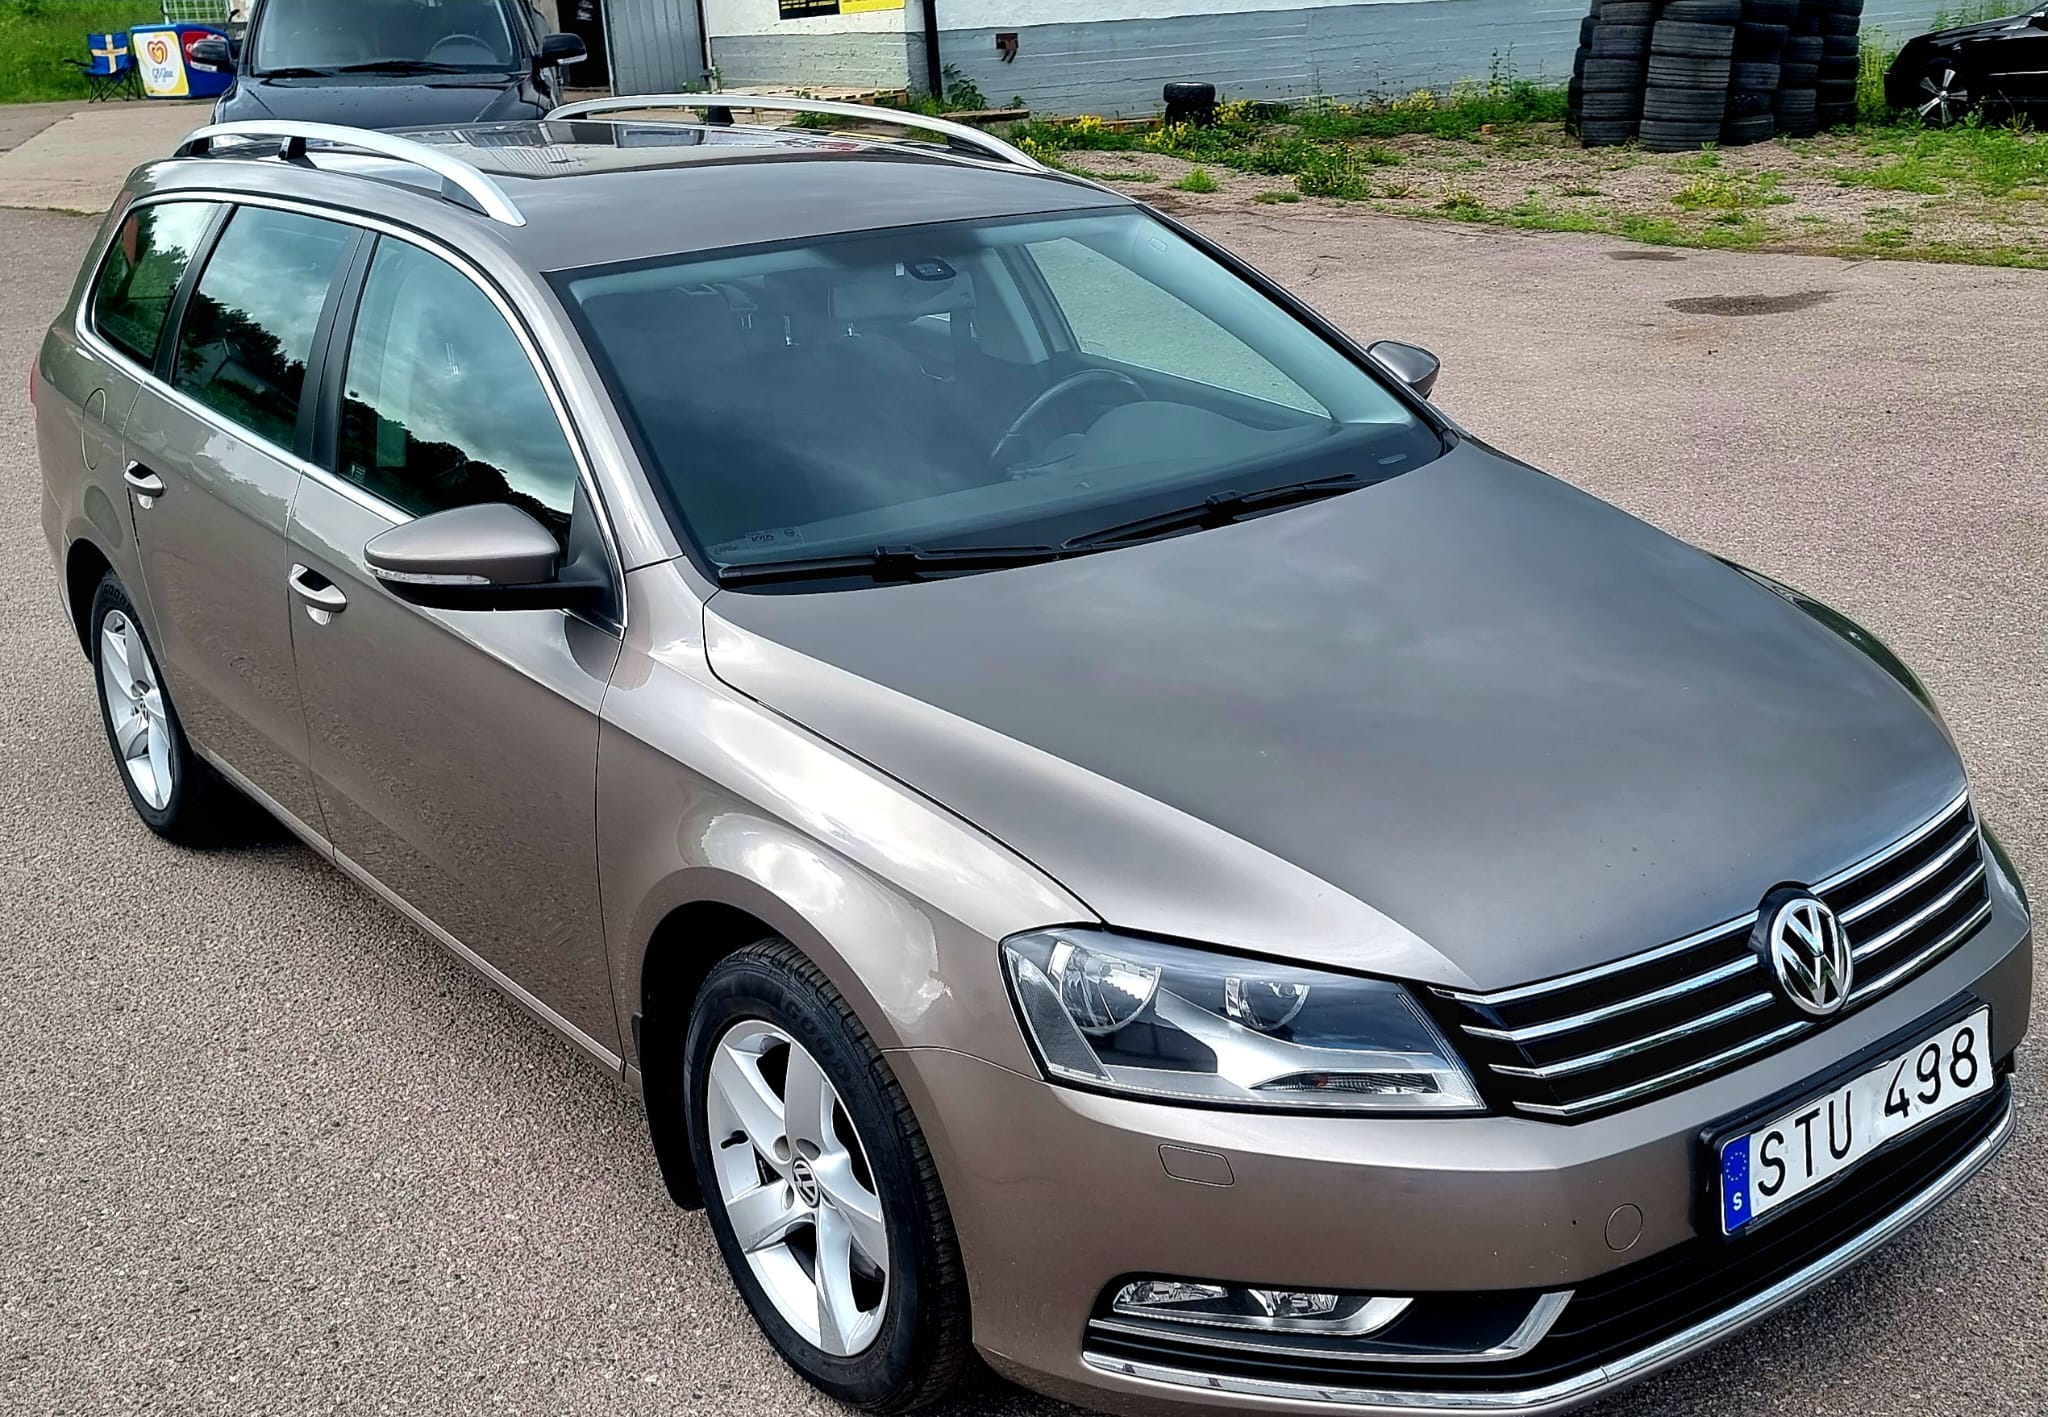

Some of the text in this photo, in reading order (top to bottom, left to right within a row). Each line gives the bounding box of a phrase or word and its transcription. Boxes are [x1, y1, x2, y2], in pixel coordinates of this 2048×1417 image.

[1757, 1026, 1978, 1197] STU 498
[1732, 1192, 1743, 1211] S
